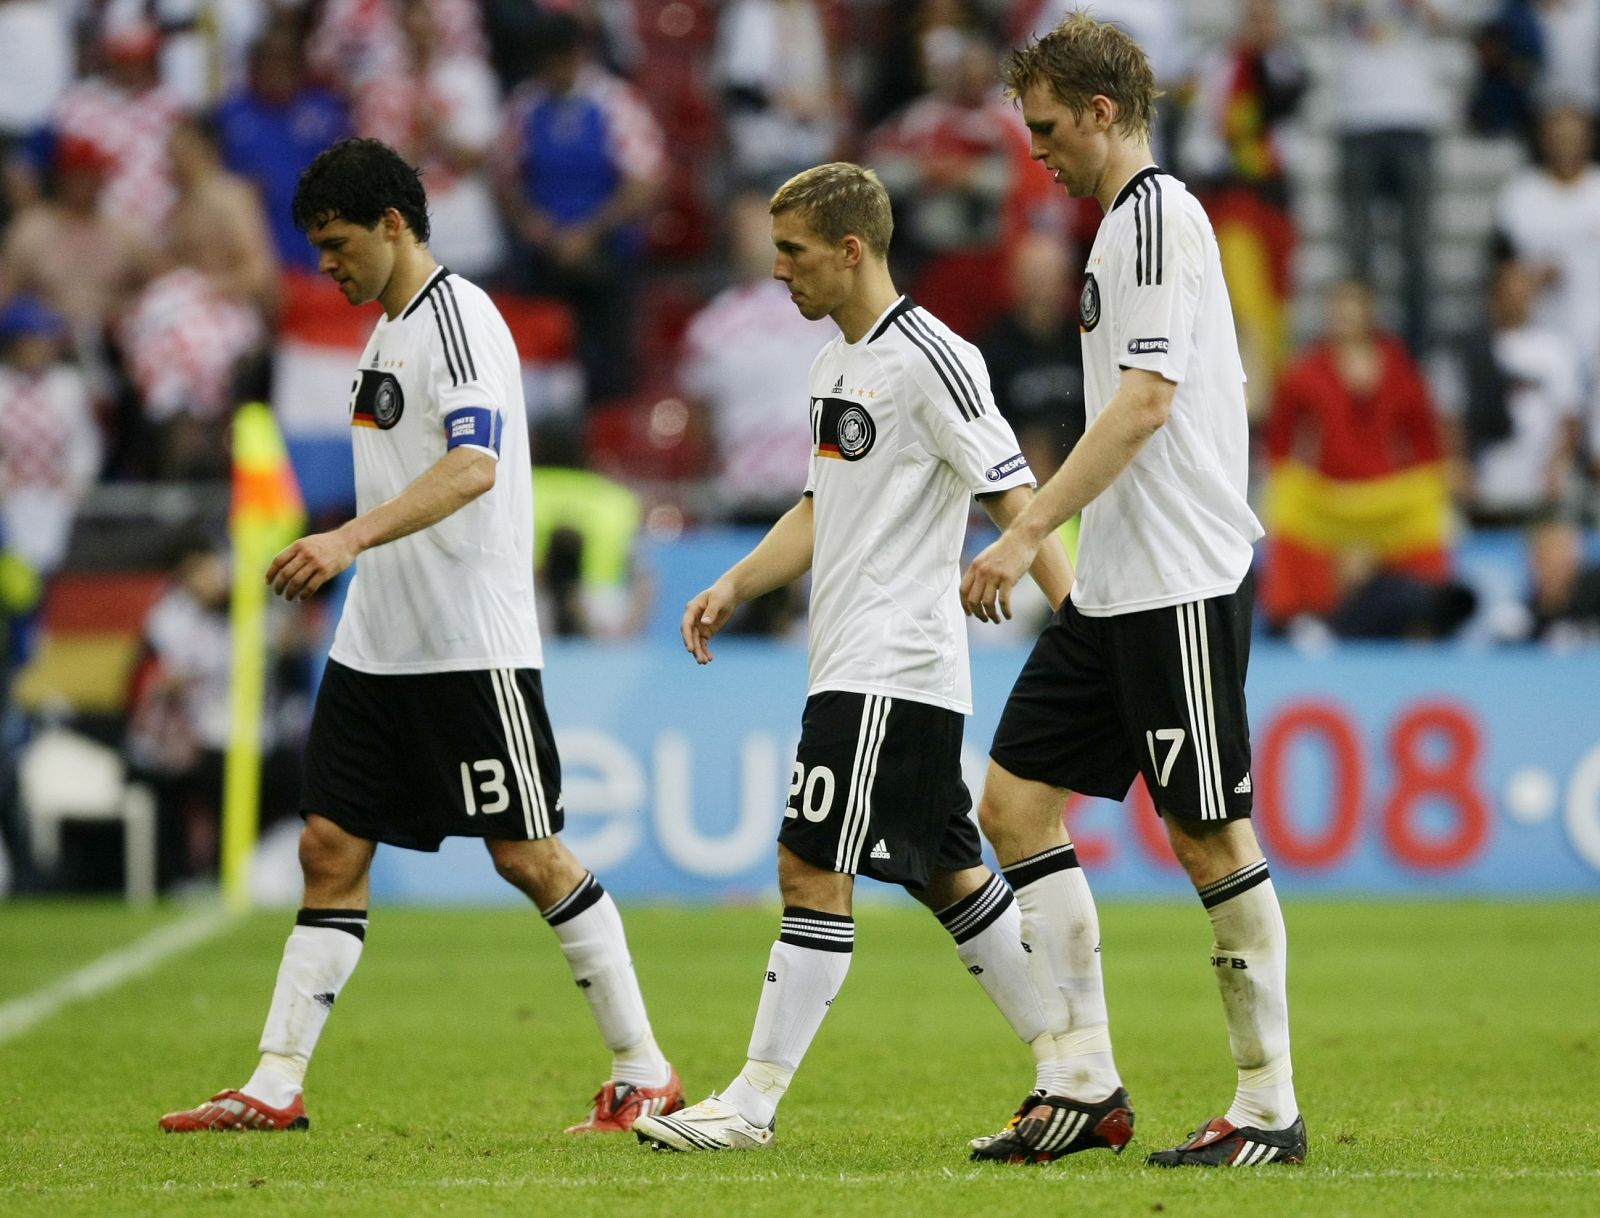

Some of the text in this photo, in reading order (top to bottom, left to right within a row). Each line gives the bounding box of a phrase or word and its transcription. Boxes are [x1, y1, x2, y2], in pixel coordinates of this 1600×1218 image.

[1146, 728, 1185, 787] 17
[461, 759, 510, 816] 13
[784, 761, 835, 823] 20
